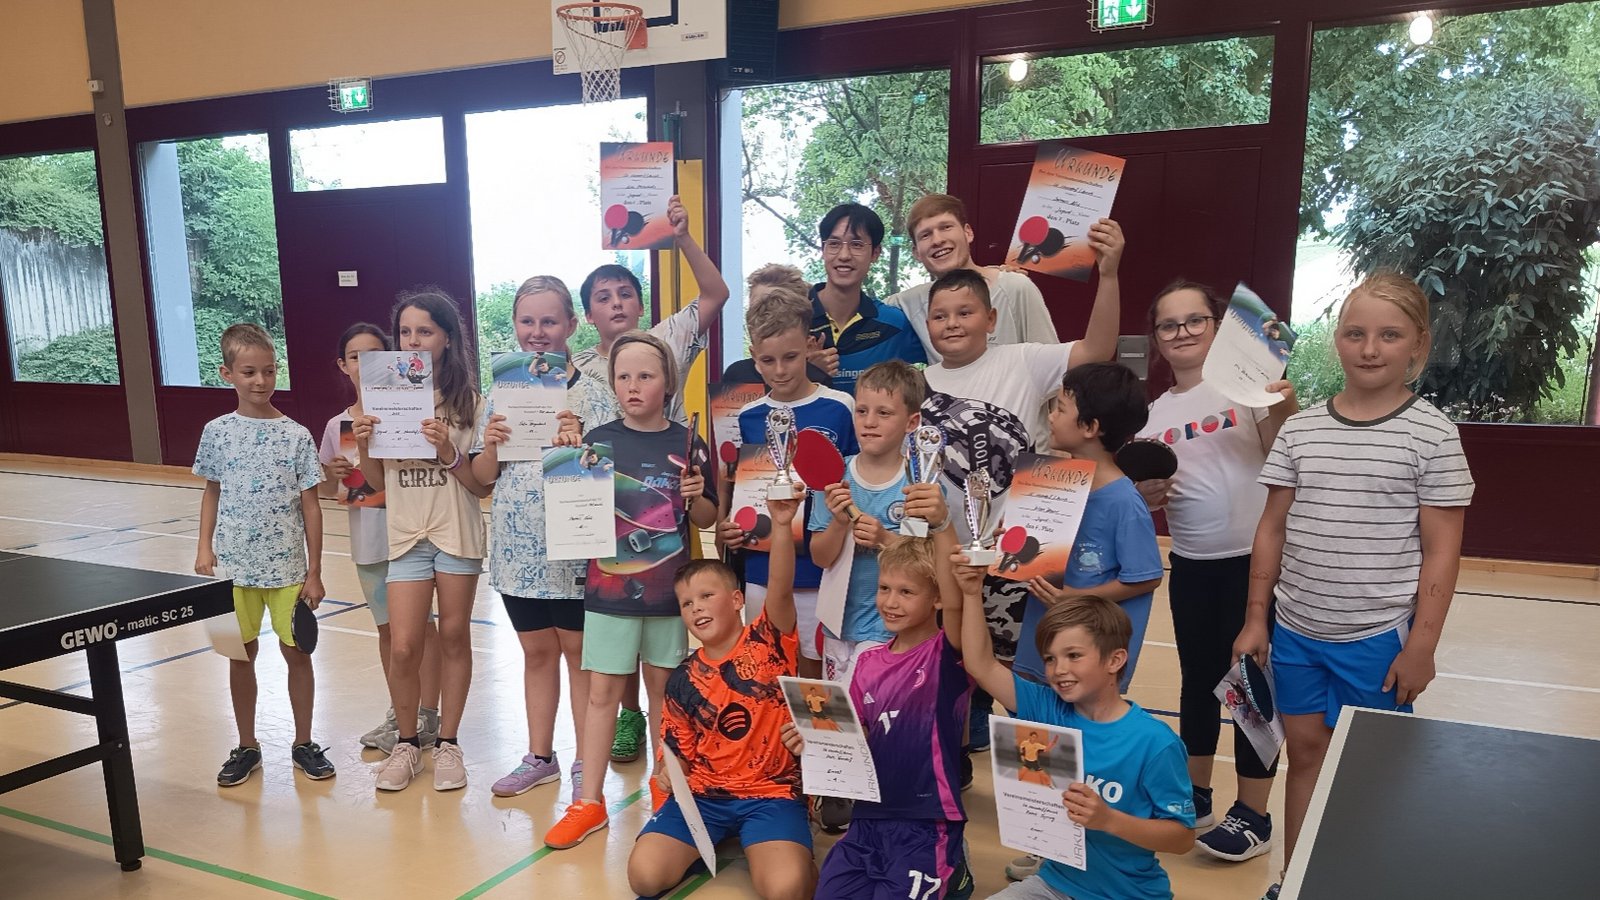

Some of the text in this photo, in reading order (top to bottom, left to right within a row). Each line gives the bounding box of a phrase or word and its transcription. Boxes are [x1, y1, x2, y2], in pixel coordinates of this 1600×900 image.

[1054, 148, 1118, 182] URKUNDE
[973, 433, 989, 469] COOL
[398, 467, 448, 488] GIRLS
[1031, 458, 1089, 486] URKUNDE
[60, 621, 118, 650] GEWO
[127, 614, 159, 631] matic
[161, 609, 178, 622] SC
[180, 605, 194, 618] 25
[1073, 821, 1083, 867] URKUN
[908, 869, 942, 900] 17
